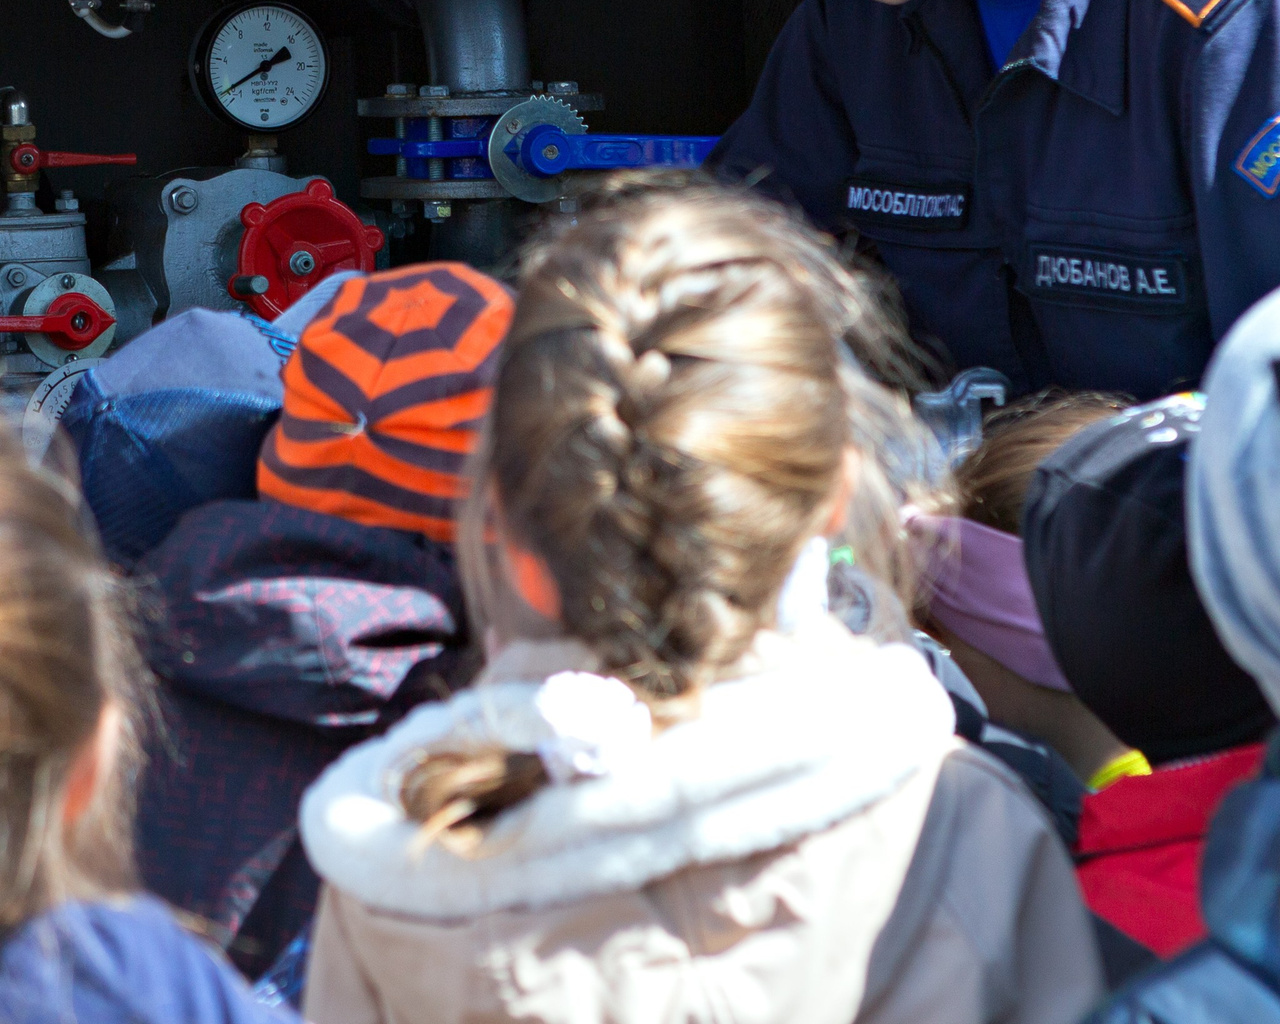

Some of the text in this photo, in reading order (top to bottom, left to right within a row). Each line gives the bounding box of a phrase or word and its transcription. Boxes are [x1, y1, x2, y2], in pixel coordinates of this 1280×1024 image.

[263, 22, 270, 31] 12
[238, 31, 243, 39] 8
[287, 35, 295, 44] 16
[297, 62, 305, 71] 20
[286, 87, 294, 96] 24
[1035, 254, 1177, 295] ДЮБАНОВ А.Е.
[44, 384, 47, 392] 2
[63, 385, 68, 393] 5
